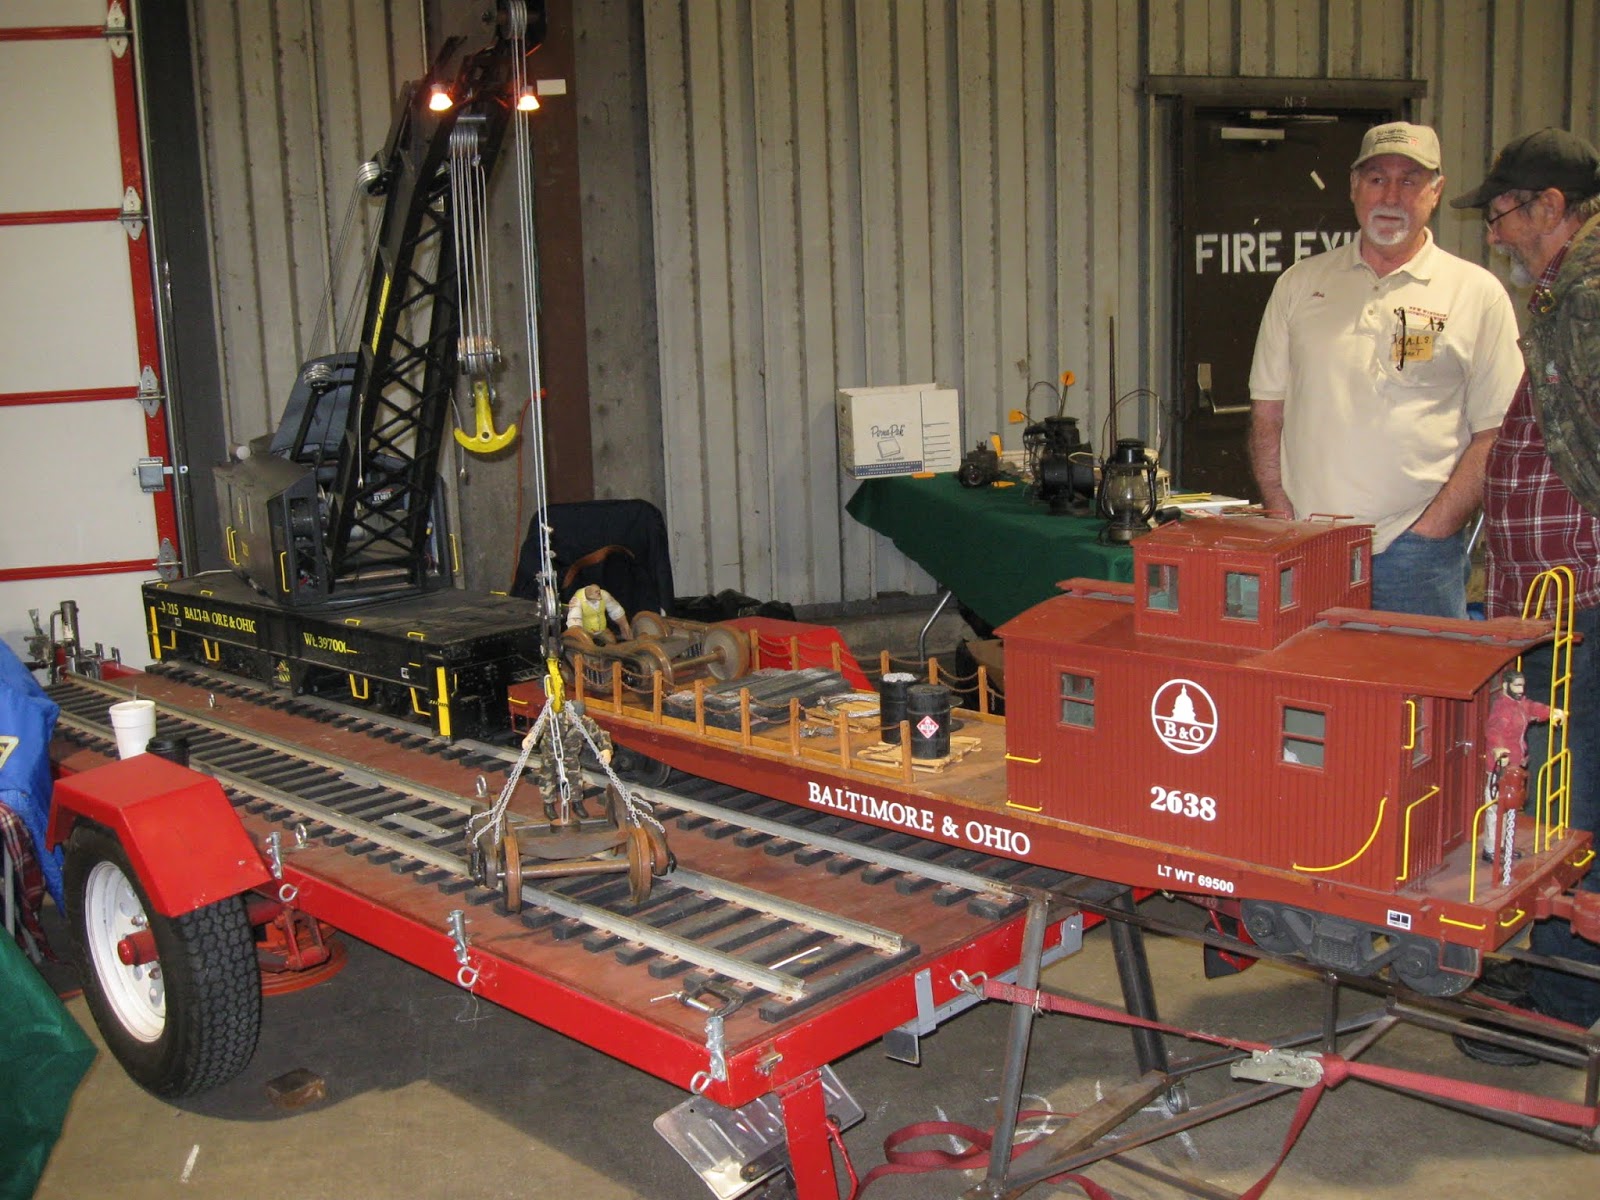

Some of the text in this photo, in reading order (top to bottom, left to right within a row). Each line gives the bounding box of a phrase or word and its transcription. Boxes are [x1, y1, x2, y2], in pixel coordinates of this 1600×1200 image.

[1196, 231, 1352, 274] FIRE EX
[229, 616, 236, 629] &
[808, 781, 1031, 856] BALTIMORE & OHIO
[1150, 786, 1216, 821] 2638
[1157, 864, 1234, 893] LT WT 69500
